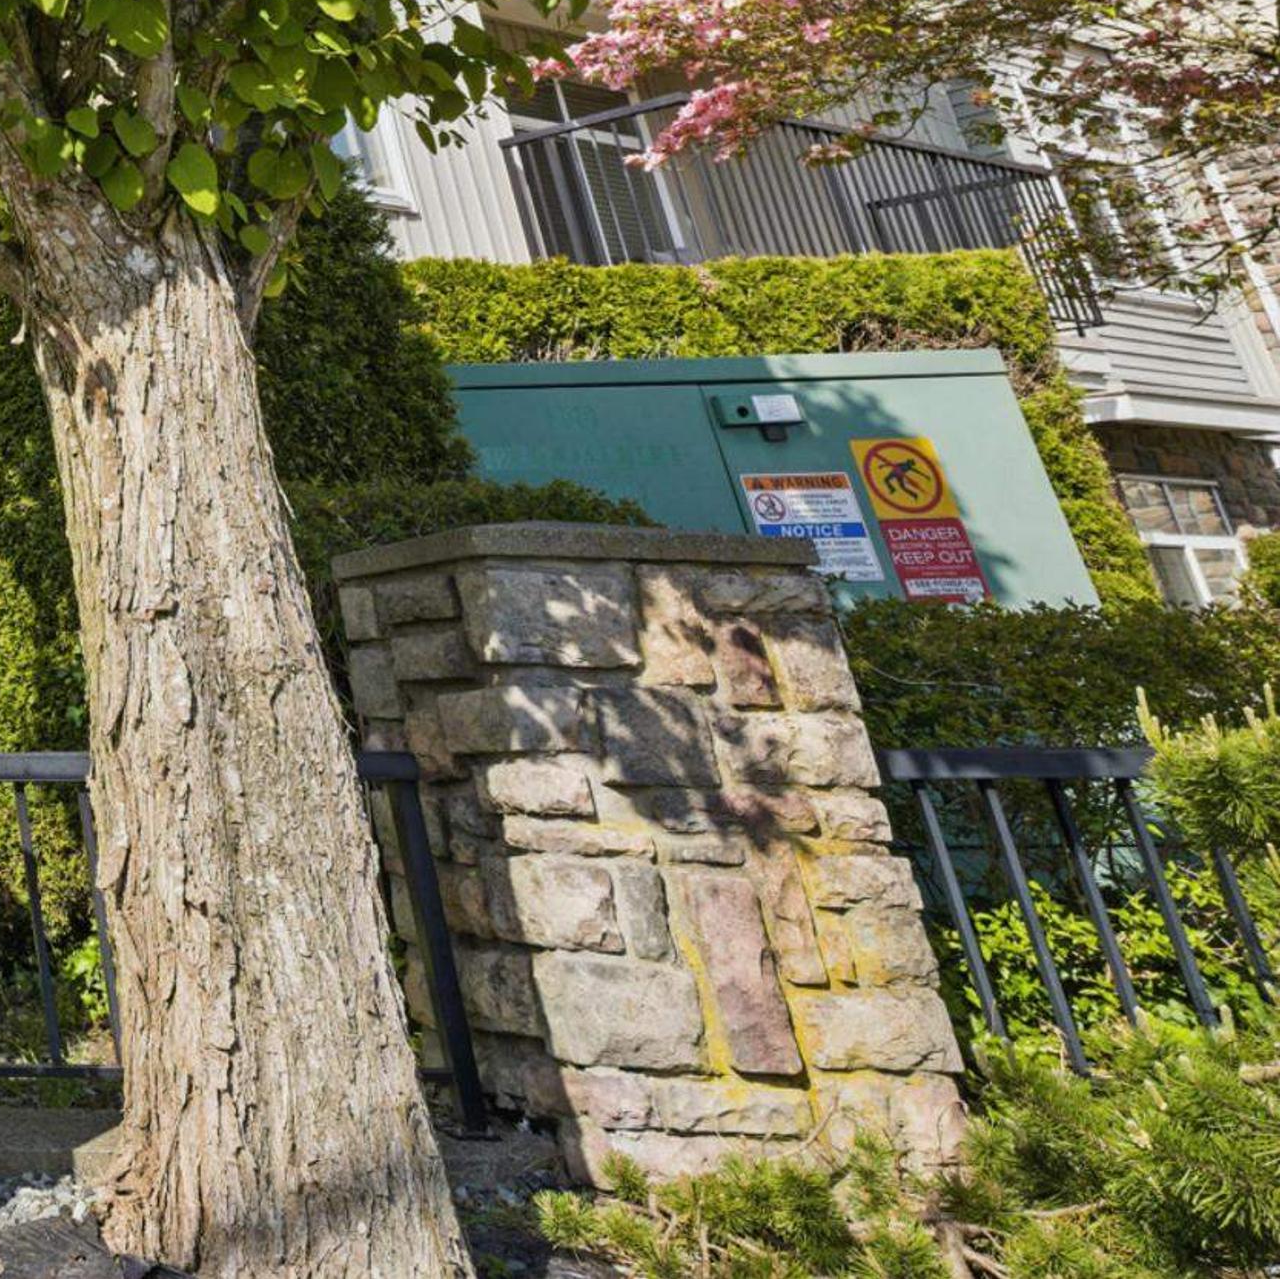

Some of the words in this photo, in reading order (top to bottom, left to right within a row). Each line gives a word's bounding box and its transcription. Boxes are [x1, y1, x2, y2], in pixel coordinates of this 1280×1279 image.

[771, 476, 844, 490] WARNING
[780, 524, 844, 538] NOTICE
[888, 526, 961, 541] DANGER
[892, 551, 935, 565] KEEP
[938, 549, 973, 564] OUT
